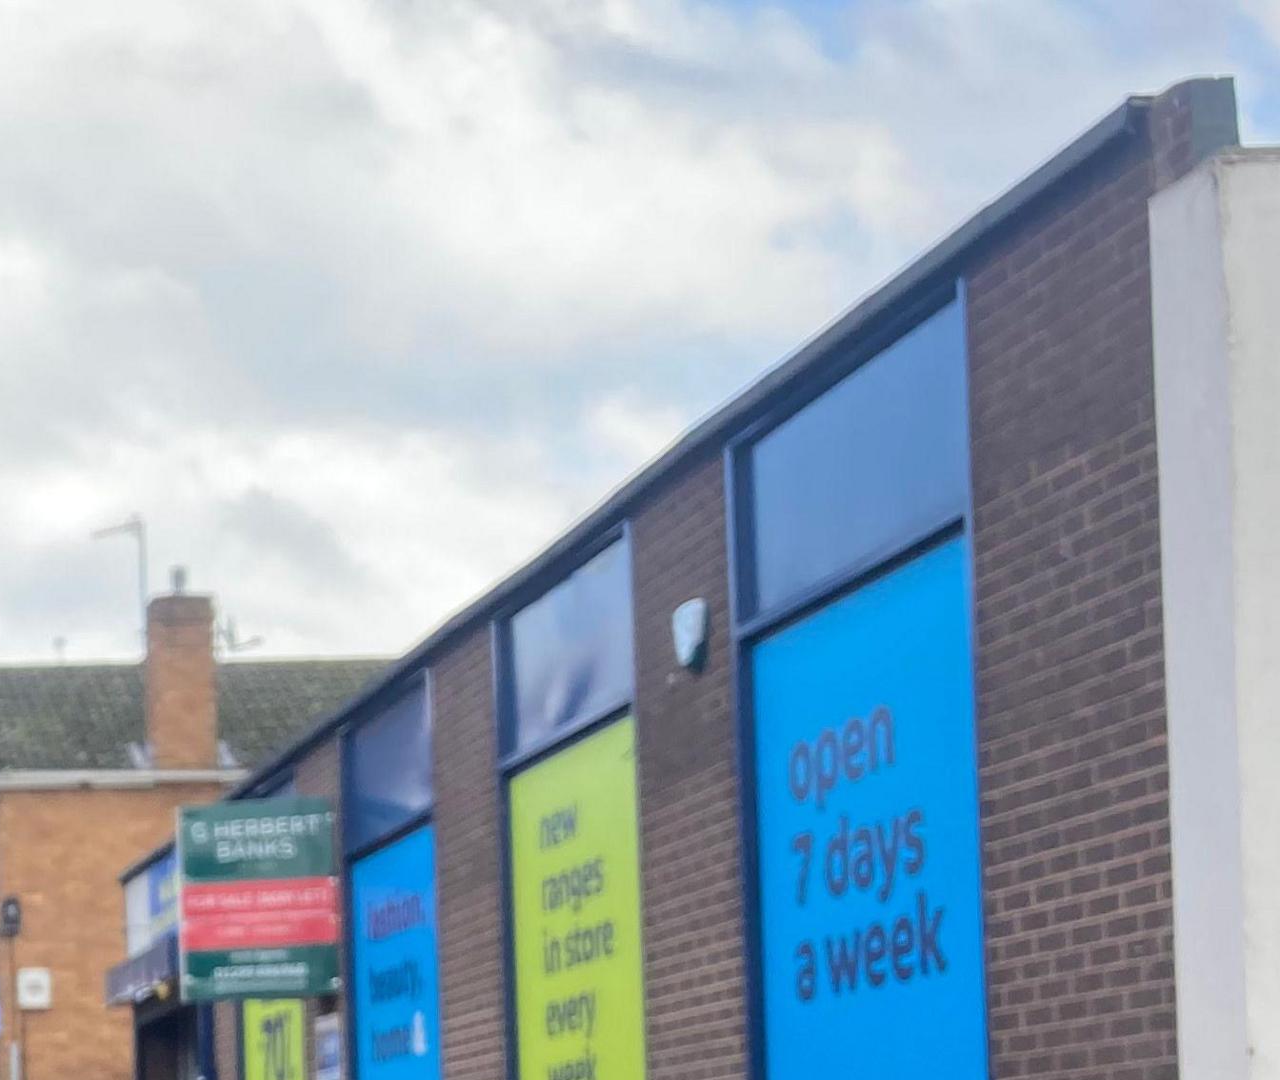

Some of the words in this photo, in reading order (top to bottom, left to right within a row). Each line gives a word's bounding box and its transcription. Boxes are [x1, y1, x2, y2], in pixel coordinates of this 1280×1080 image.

[790, 704, 896, 811] open
[214, 813, 321, 837] HERBERT
[216, 838, 296, 863] BANKS
[539, 803, 578, 850] new
[541, 857, 605, 912] ranges
[793, 832, 814, 906] 7
[825, 809, 926, 903] days
[543, 927, 562, 975] in
[565, 918, 615, 967] store
[796, 940, 816, 1002] a
[825, 890, 947, 994] week
[546, 990, 596, 1042] every
